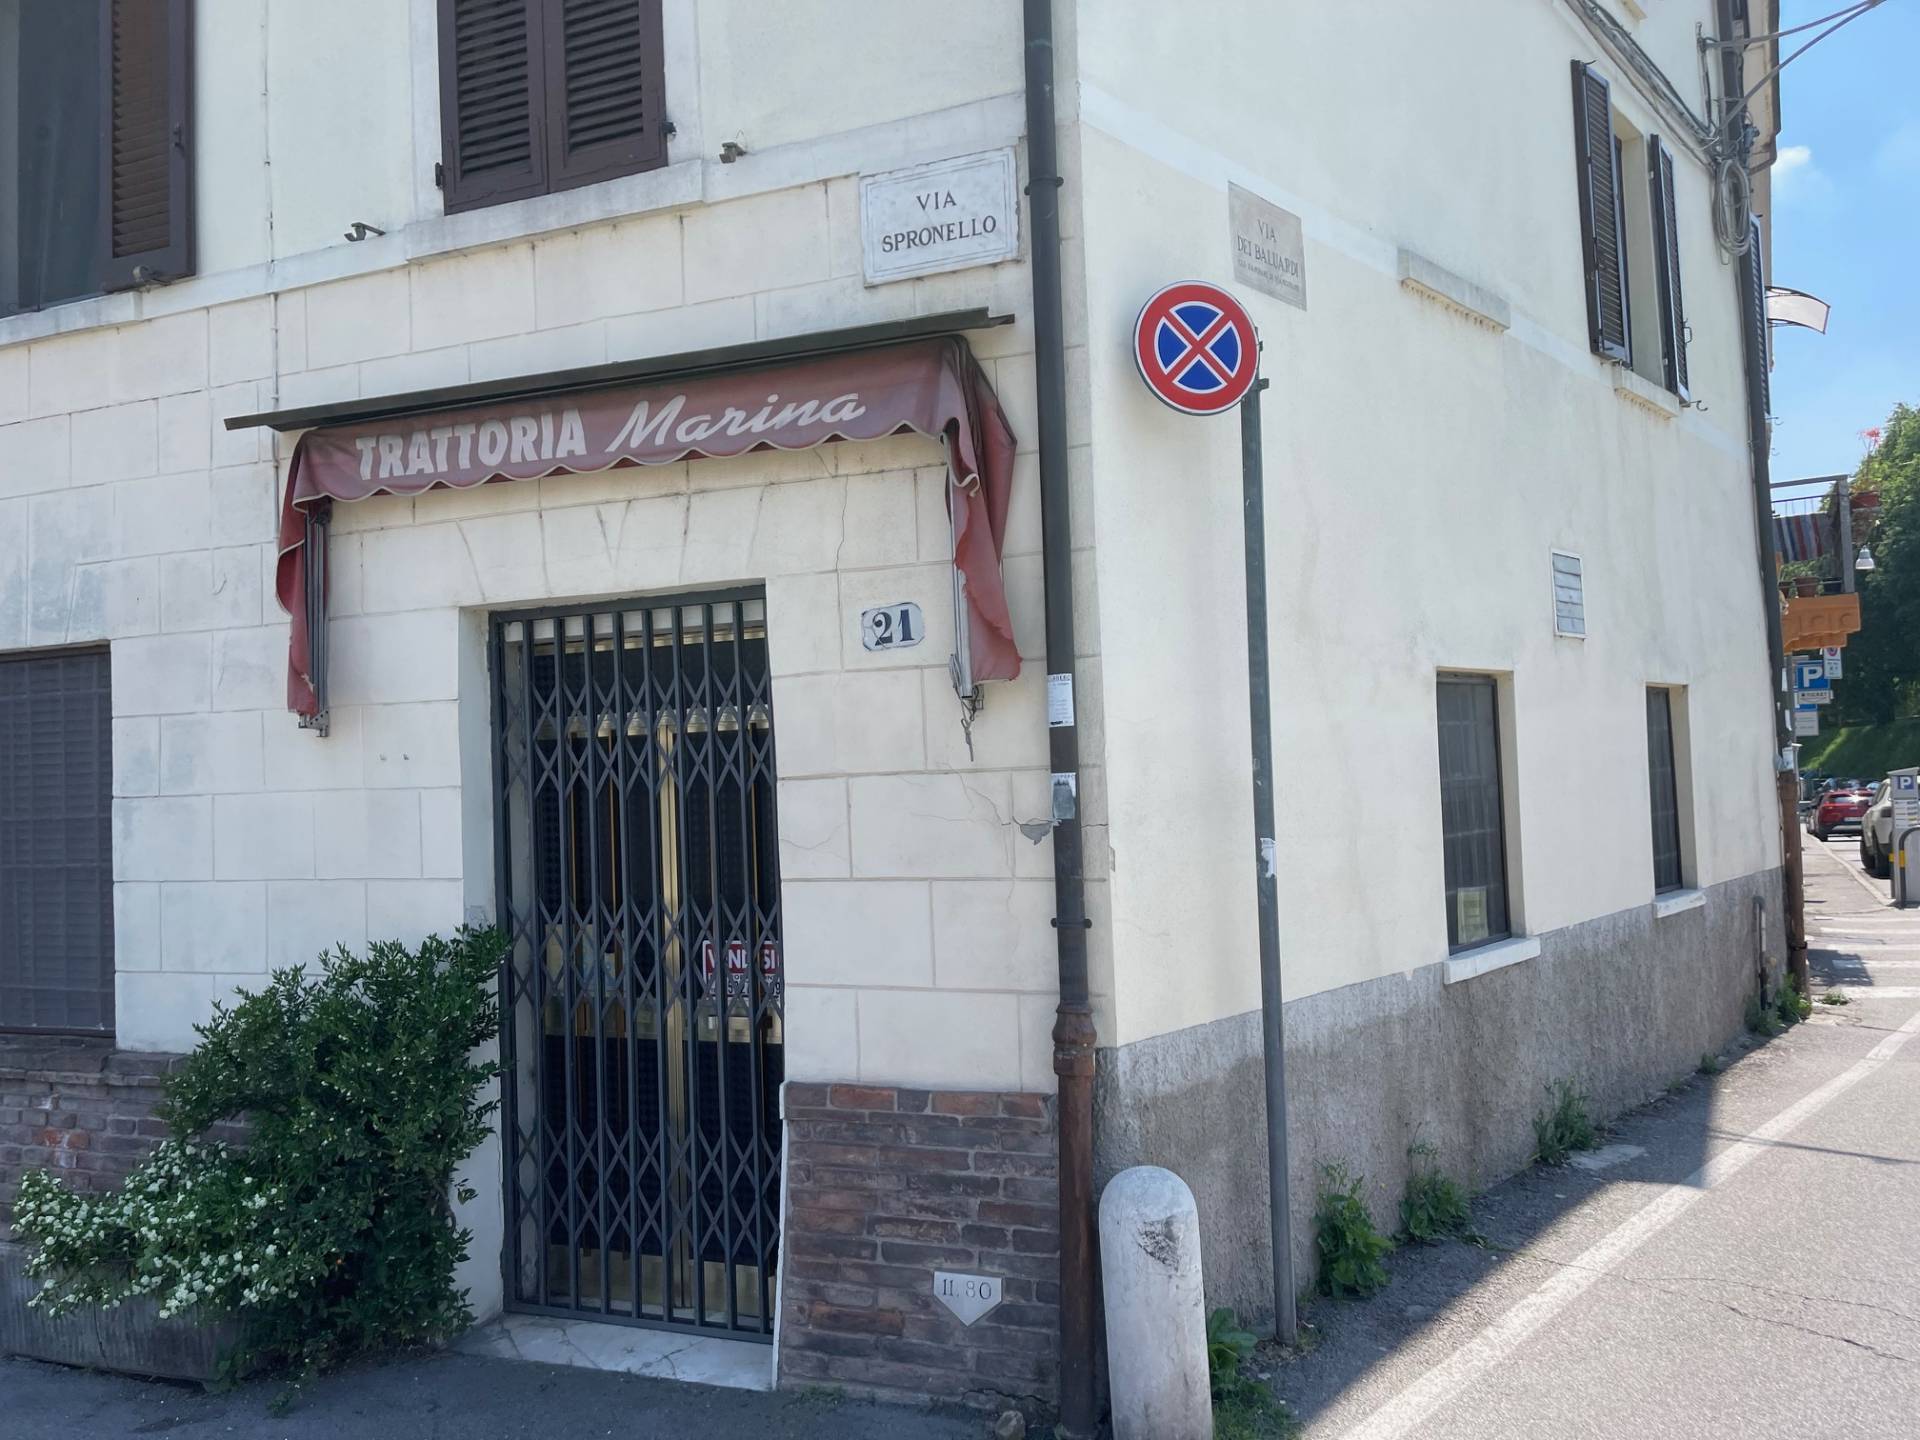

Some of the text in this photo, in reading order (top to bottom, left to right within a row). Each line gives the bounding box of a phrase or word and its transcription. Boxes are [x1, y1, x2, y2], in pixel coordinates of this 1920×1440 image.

[916, 190, 957, 211] VIA
[881, 215, 997, 253] SPRONELLO
[1257, 219, 1277, 243] VIA
[1237, 234, 1252, 256] DEI
[1255, 244, 1299, 277] BALUARDI
[355, 392, 866, 481] TRATTORIA Marina
[872, 608, 915, 646] 21
[1803, 666, 1823, 688] P
[1900, 776, 1911, 789] P
